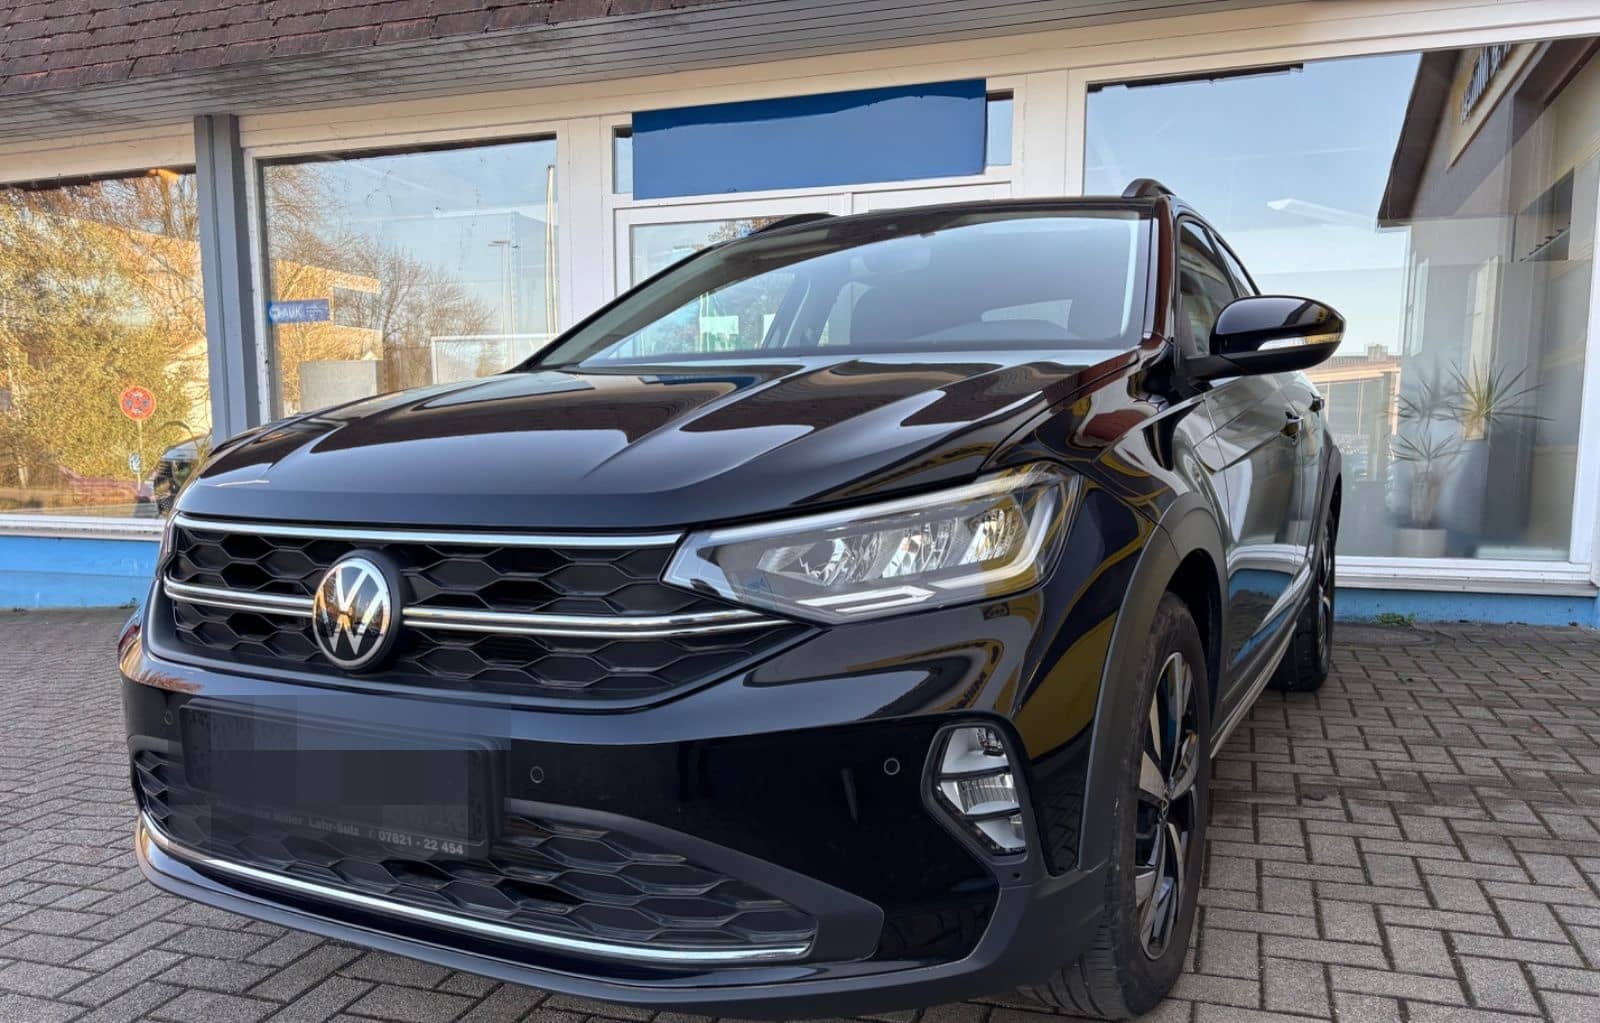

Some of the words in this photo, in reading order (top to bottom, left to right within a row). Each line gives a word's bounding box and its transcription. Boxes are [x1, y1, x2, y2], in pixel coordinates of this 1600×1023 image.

[317, 563, 389, 657] VW
[378, 830, 412, 847] 07821
[423, 838, 439, 850] 22
[441, 842, 464, 856] 454
